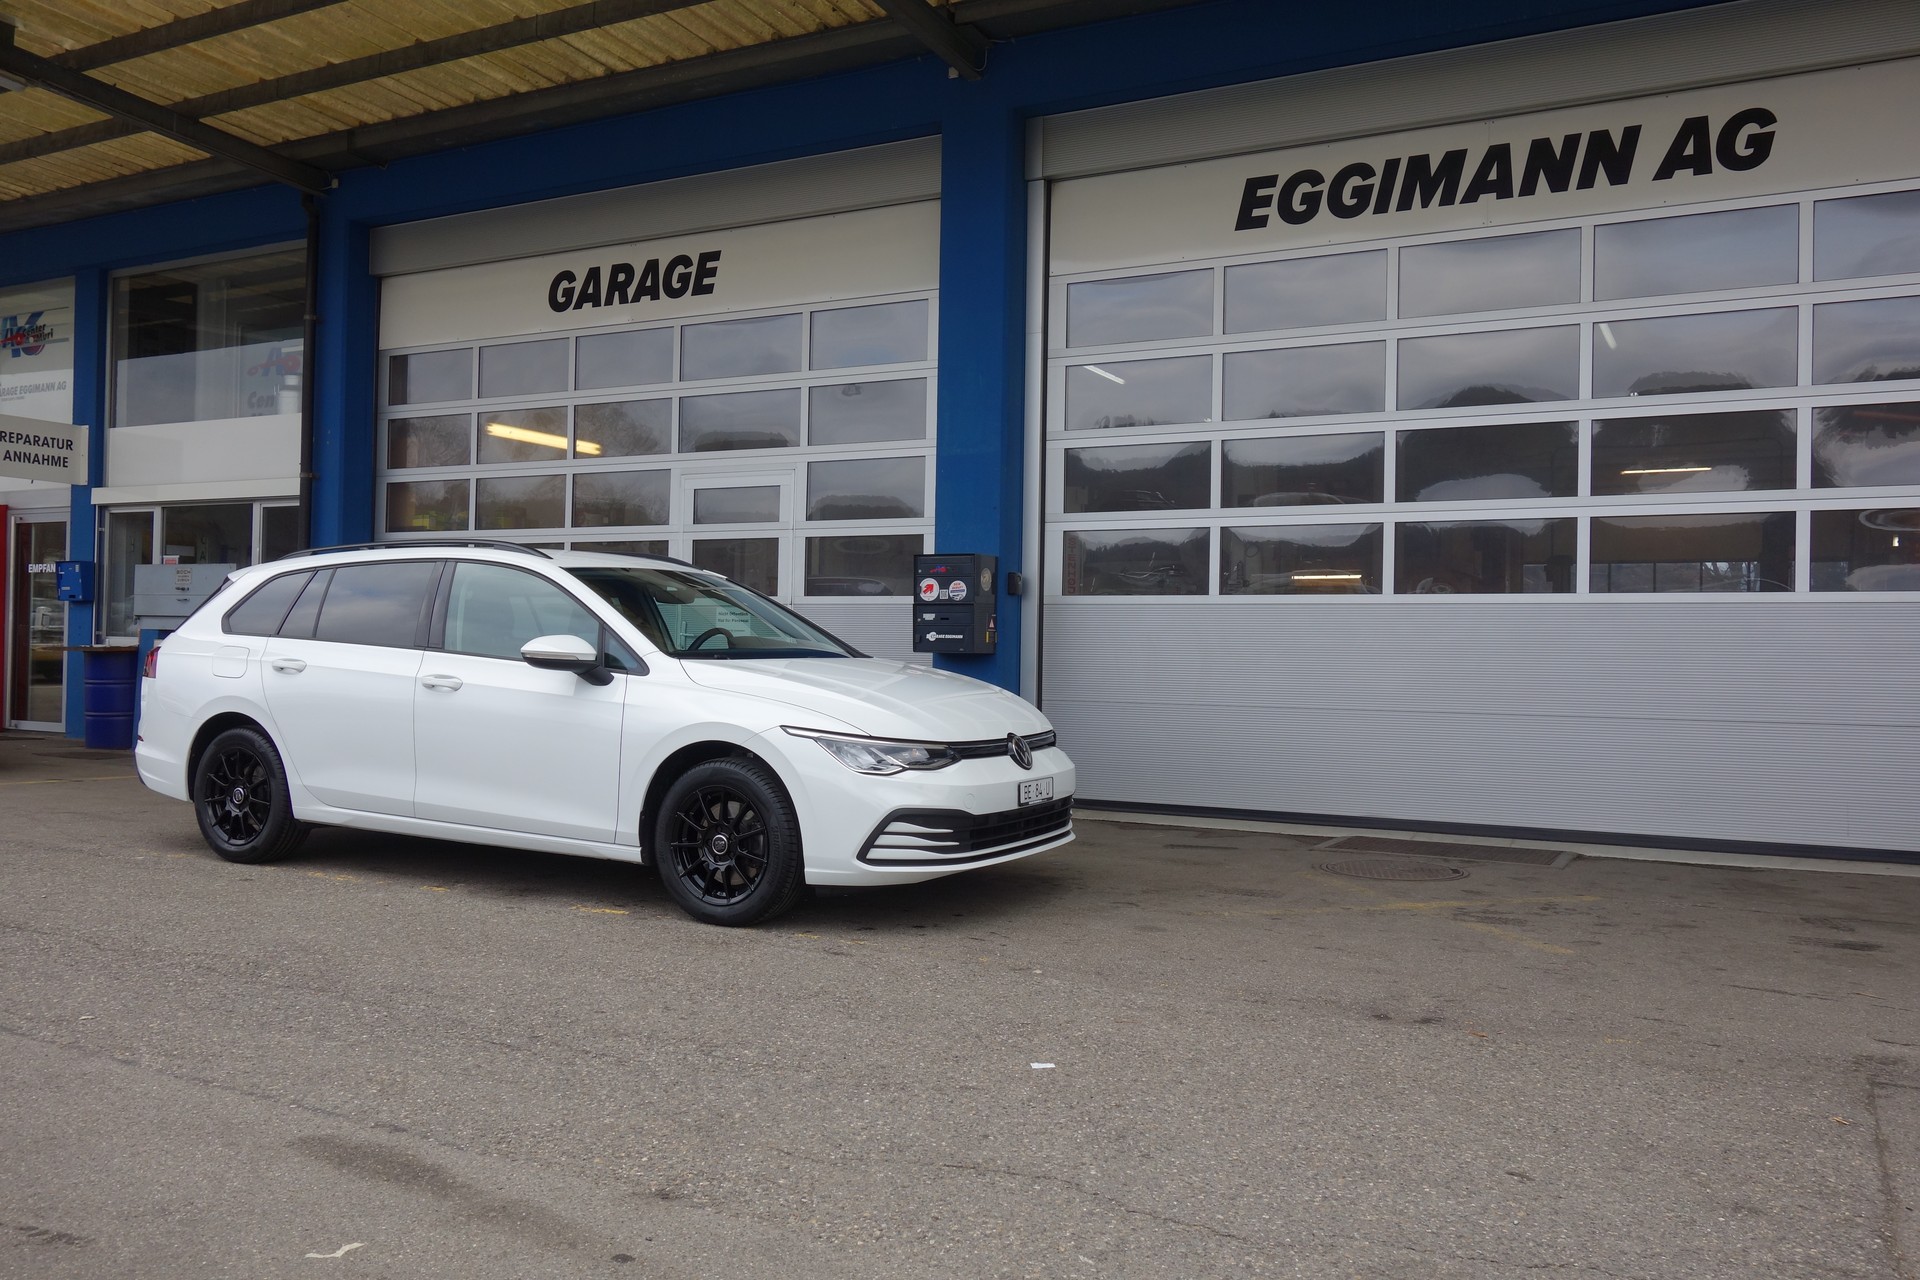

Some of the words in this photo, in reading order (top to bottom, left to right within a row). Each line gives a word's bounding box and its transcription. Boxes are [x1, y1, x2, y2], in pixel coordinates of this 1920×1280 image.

[1234, 124, 1642, 232] EGGIMANN
[1652, 107, 1778, 182] AG
[548, 249, 722, 313] GARAGE
[19, 382, 56, 395] EGGIMANN
[57, 380, 67, 391] AG
[0, 430, 74, 451] REPARATUR
[3, 449, 69, 468] ANNAHME
[28, 563, 56, 573] EMPFAN
